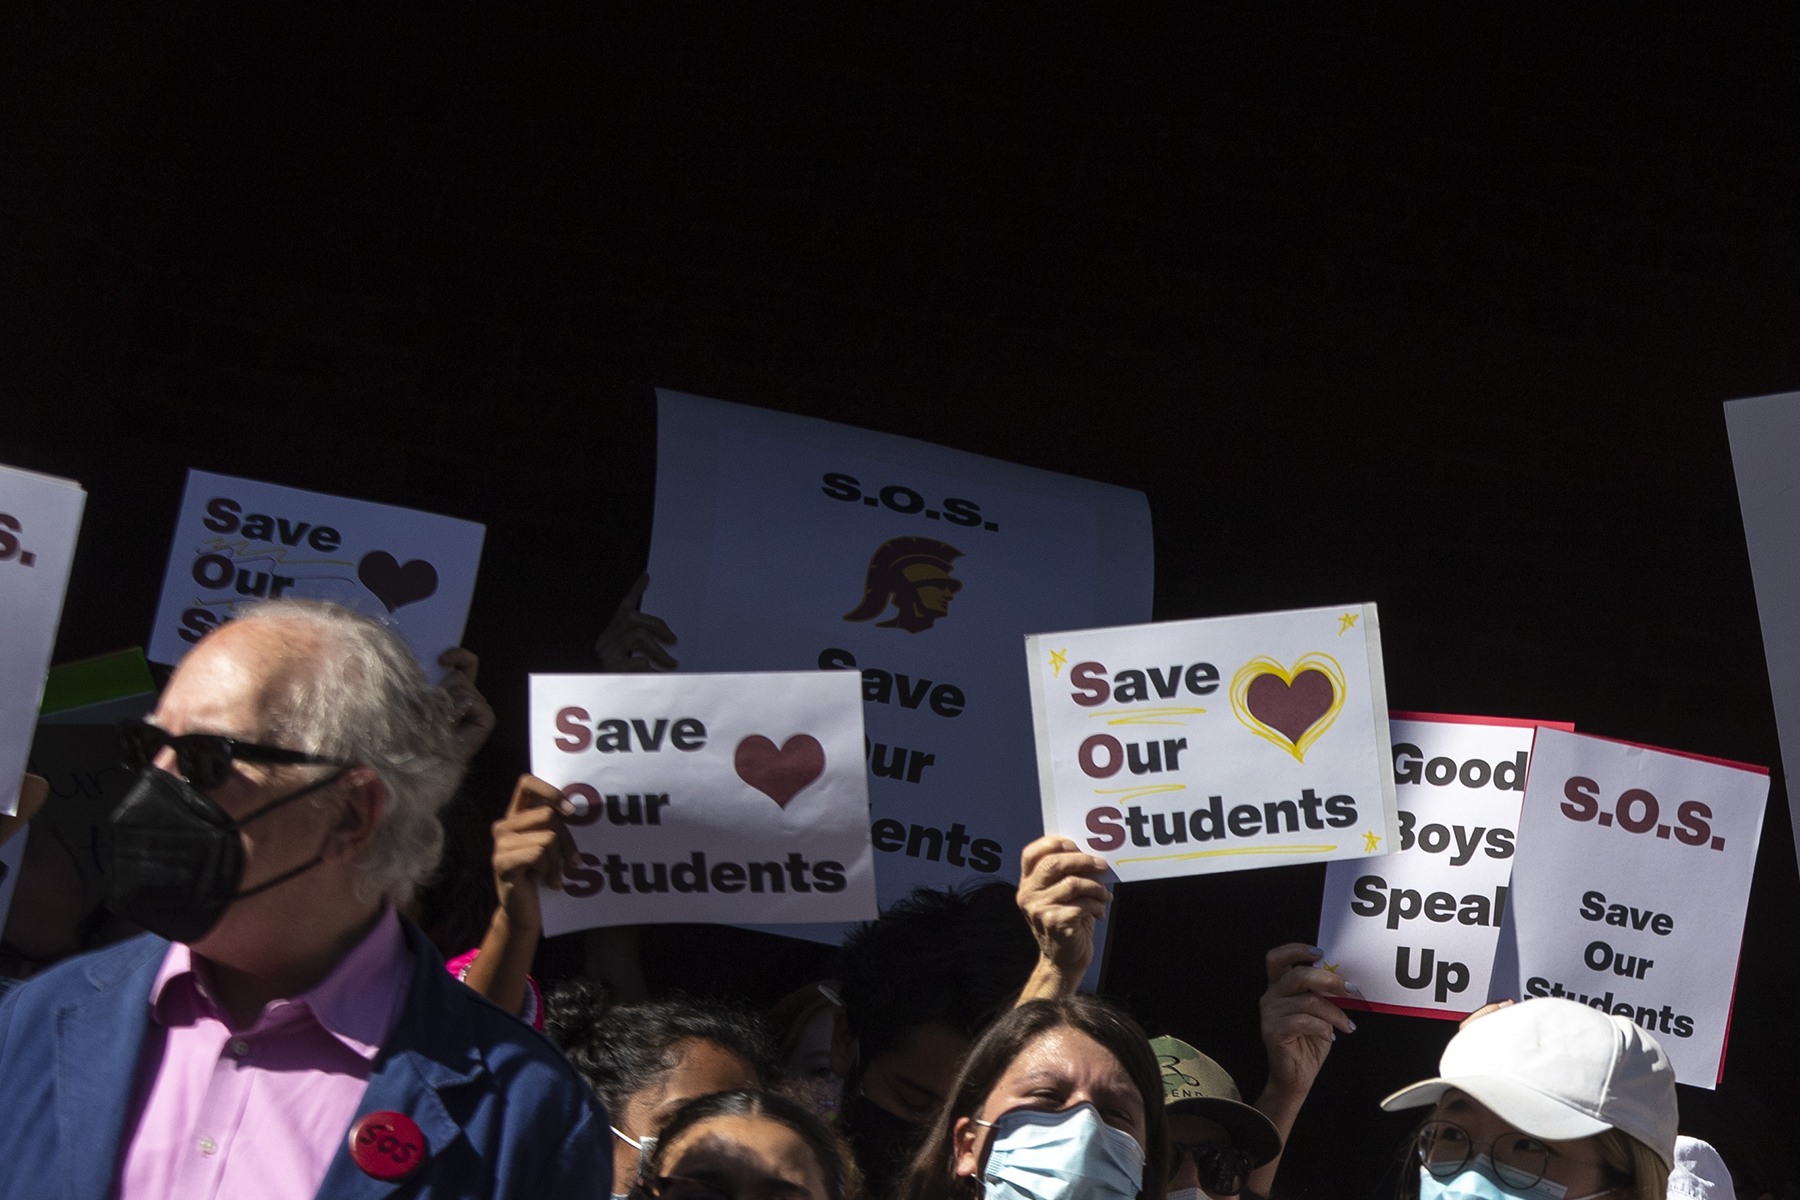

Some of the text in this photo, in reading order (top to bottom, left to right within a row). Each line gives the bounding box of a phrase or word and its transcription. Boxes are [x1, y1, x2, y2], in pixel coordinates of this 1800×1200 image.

[203, 497, 342, 552] Save
[821, 472, 1000, 532] S.O.S.
[192, 554, 296, 598] Our
[1070, 661, 1220, 707] Save
[555, 706, 707, 755] Save
[864, 732, 936, 784] ur
[1078, 734, 1187, 780] Our
[1391, 742, 1528, 792] Good
[560, 783, 670, 826] Our
[1085, 788, 1358, 852] Students
[1560, 775, 1726, 853] S.O.S.
[870, 816, 1003, 874] ents
[560, 852, 847, 898] Students
[1579, 891, 1674, 936] Save
[1395, 946, 1470, 1003] Up
[1583, 941, 1654, 980] Our
[358, 1124, 418, 1164] SOS
